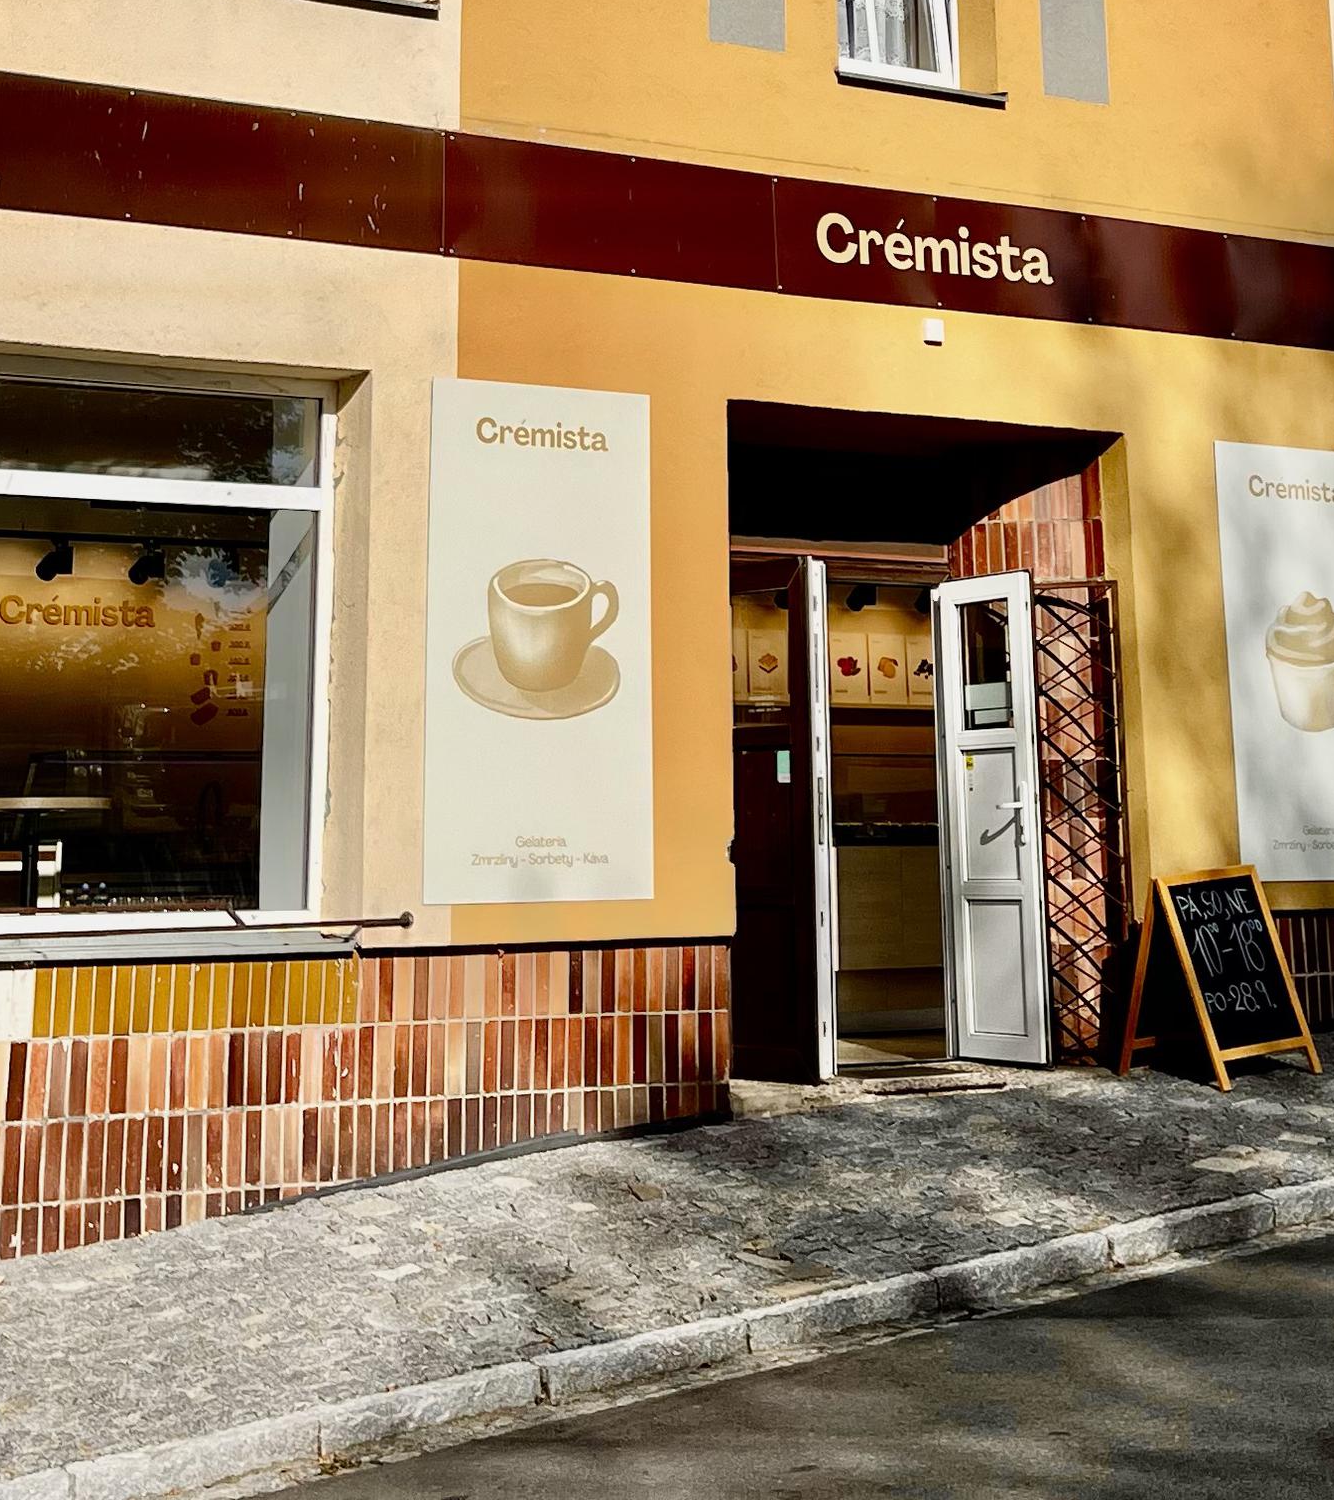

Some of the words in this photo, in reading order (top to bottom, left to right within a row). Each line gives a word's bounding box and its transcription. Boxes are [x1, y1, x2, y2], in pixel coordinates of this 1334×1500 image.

[816, 212, 1055, 286] Crémista
[476, 416, 609, 452] Crémista
[528, 852, 574, 867] Sorbety
